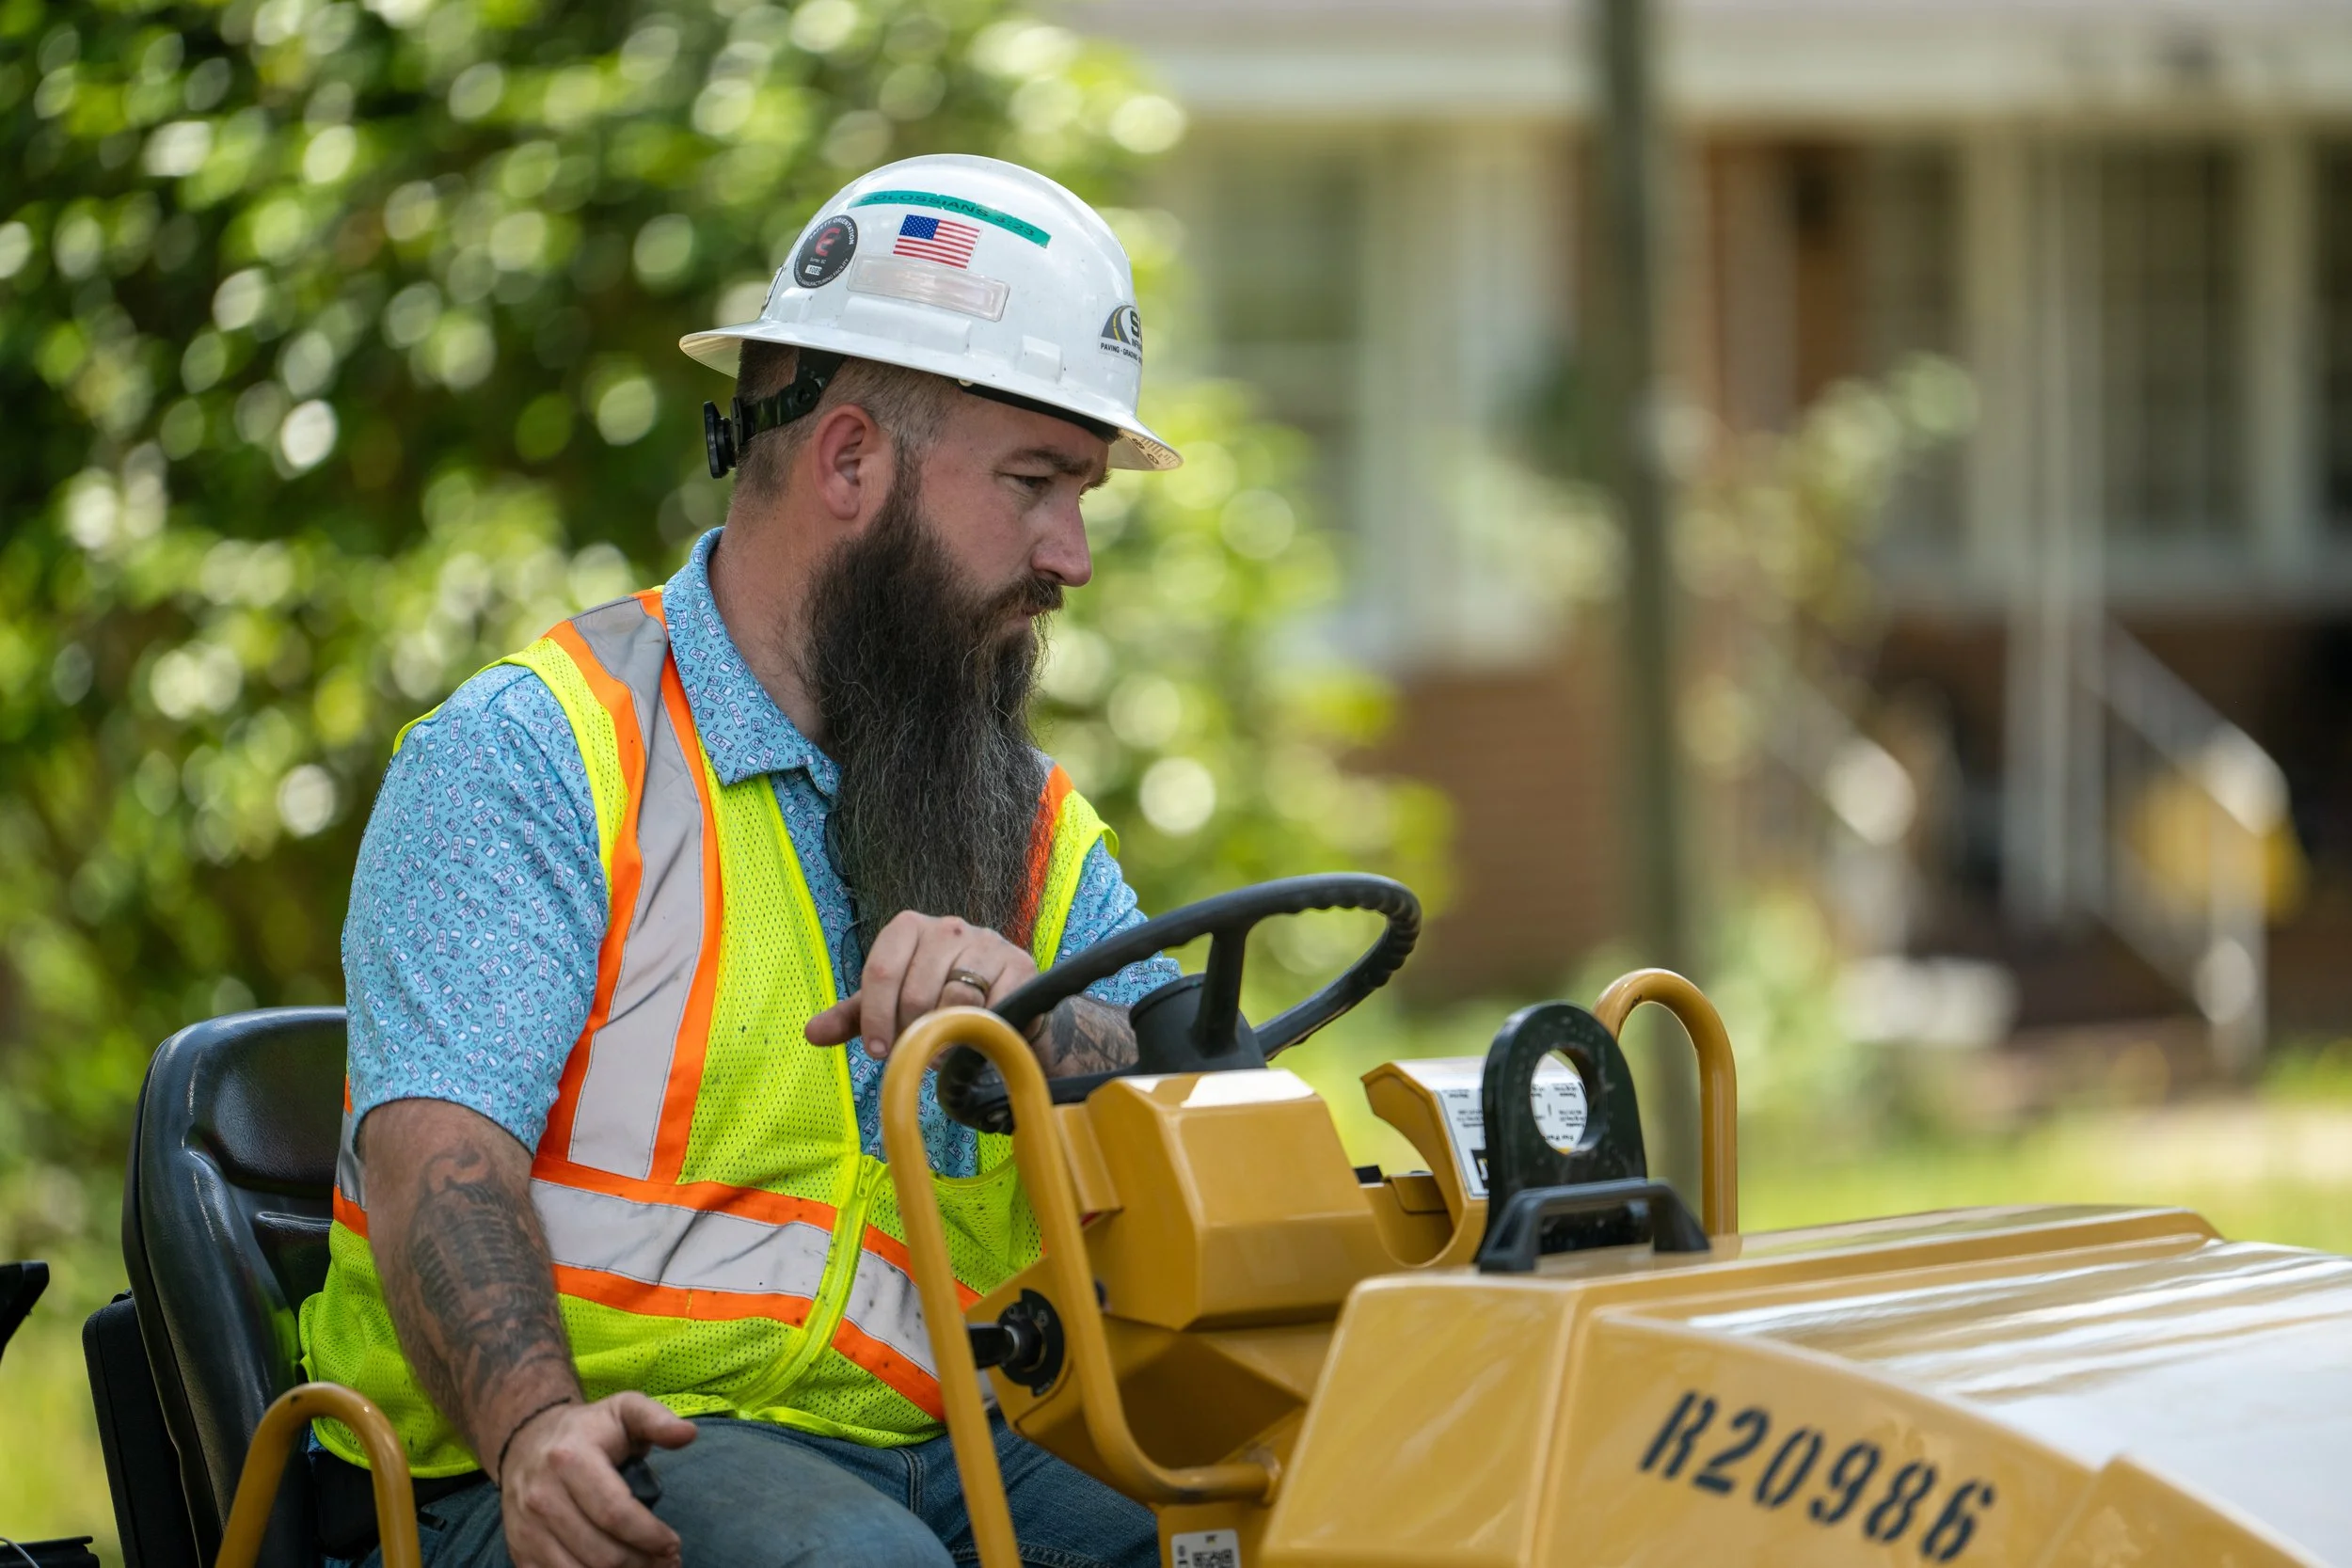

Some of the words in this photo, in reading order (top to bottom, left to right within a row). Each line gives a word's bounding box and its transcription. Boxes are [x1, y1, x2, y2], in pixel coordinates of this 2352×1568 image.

[860, 194, 989, 217] COLOSSIANS
[995, 215, 1035, 236] 3:23
[809, 219, 833, 240] SAFETY
[833, 217, 855, 245] ORIENTATION
[834, 258, 850, 277] FACILITY
[1100, 342, 1120, 354] PAVING
[1640, 1390, 1995, 1564] R20986
